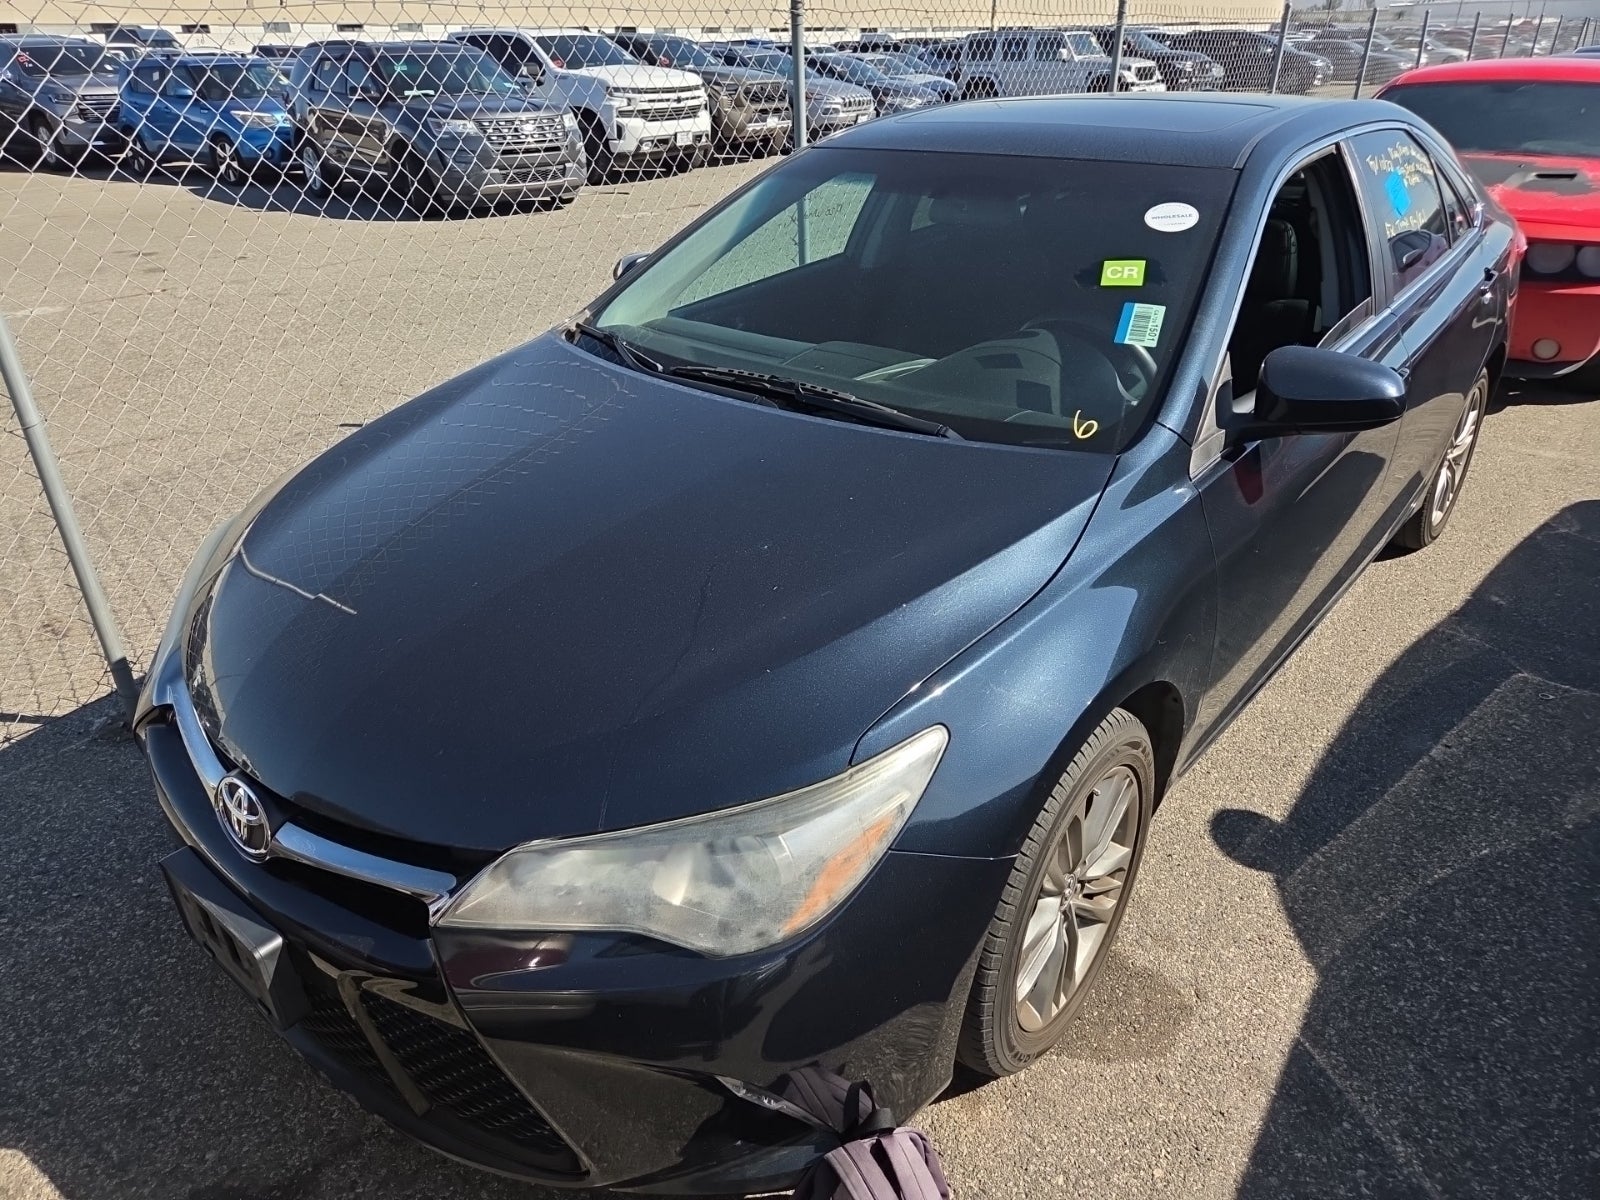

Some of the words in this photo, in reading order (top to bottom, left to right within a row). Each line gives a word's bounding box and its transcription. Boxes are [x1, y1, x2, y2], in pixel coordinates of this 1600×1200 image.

[1106, 266, 1139, 279] CR
[1146, 324, 1159, 341] 1501
[1073, 409, 1099, 439] 6
